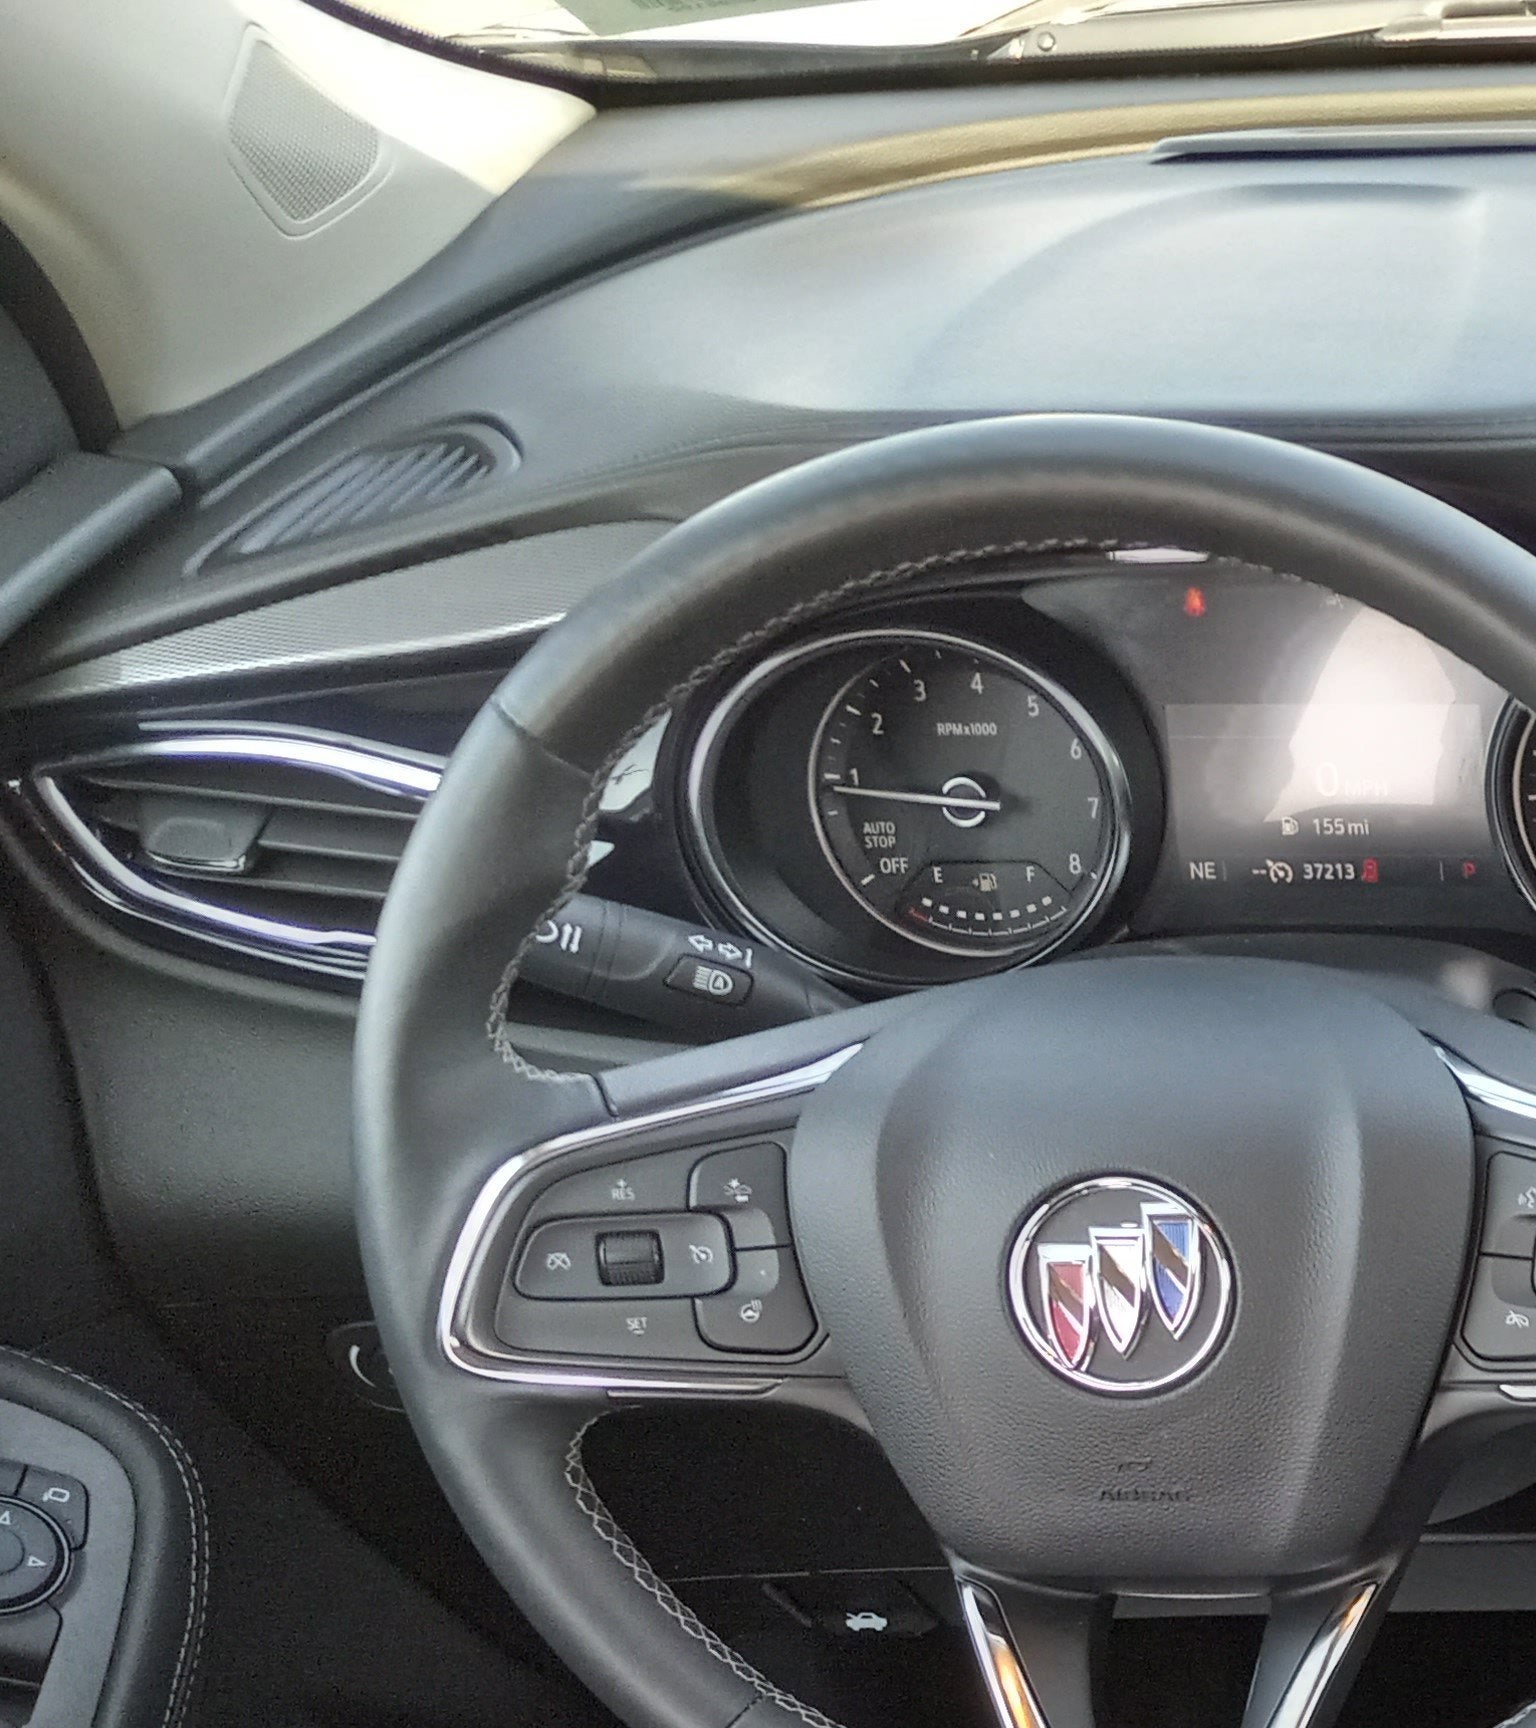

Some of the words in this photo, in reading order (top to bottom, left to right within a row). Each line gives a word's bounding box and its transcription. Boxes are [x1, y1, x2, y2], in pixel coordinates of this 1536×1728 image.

[913, 680, 926, 702] 3
[971, 673, 984, 695] 4
[1027, 695, 1040, 717] 5
[871, 714, 884, 735] 2
[936, 722, 997, 737] RPMx1000
[1070, 737, 1082, 760] 6
[850, 768, 859, 786] 1
[1345, 781, 1389, 797] MPH
[1088, 797, 1099, 819] 7
[863, 822, 896, 835] AUTO
[864, 835, 896, 849] STOP
[879, 858, 909, 874] OFF
[1068, 853, 1081, 873] 8
[1189, 861, 1217, 879] NE
[1303, 863, 1356, 880] 37213
[933, 867, 943, 884] E
[1026, 866, 1035, 881] F
[612, 1187, 635, 1200] RES
[627, 1317, 647, 1329] SET
